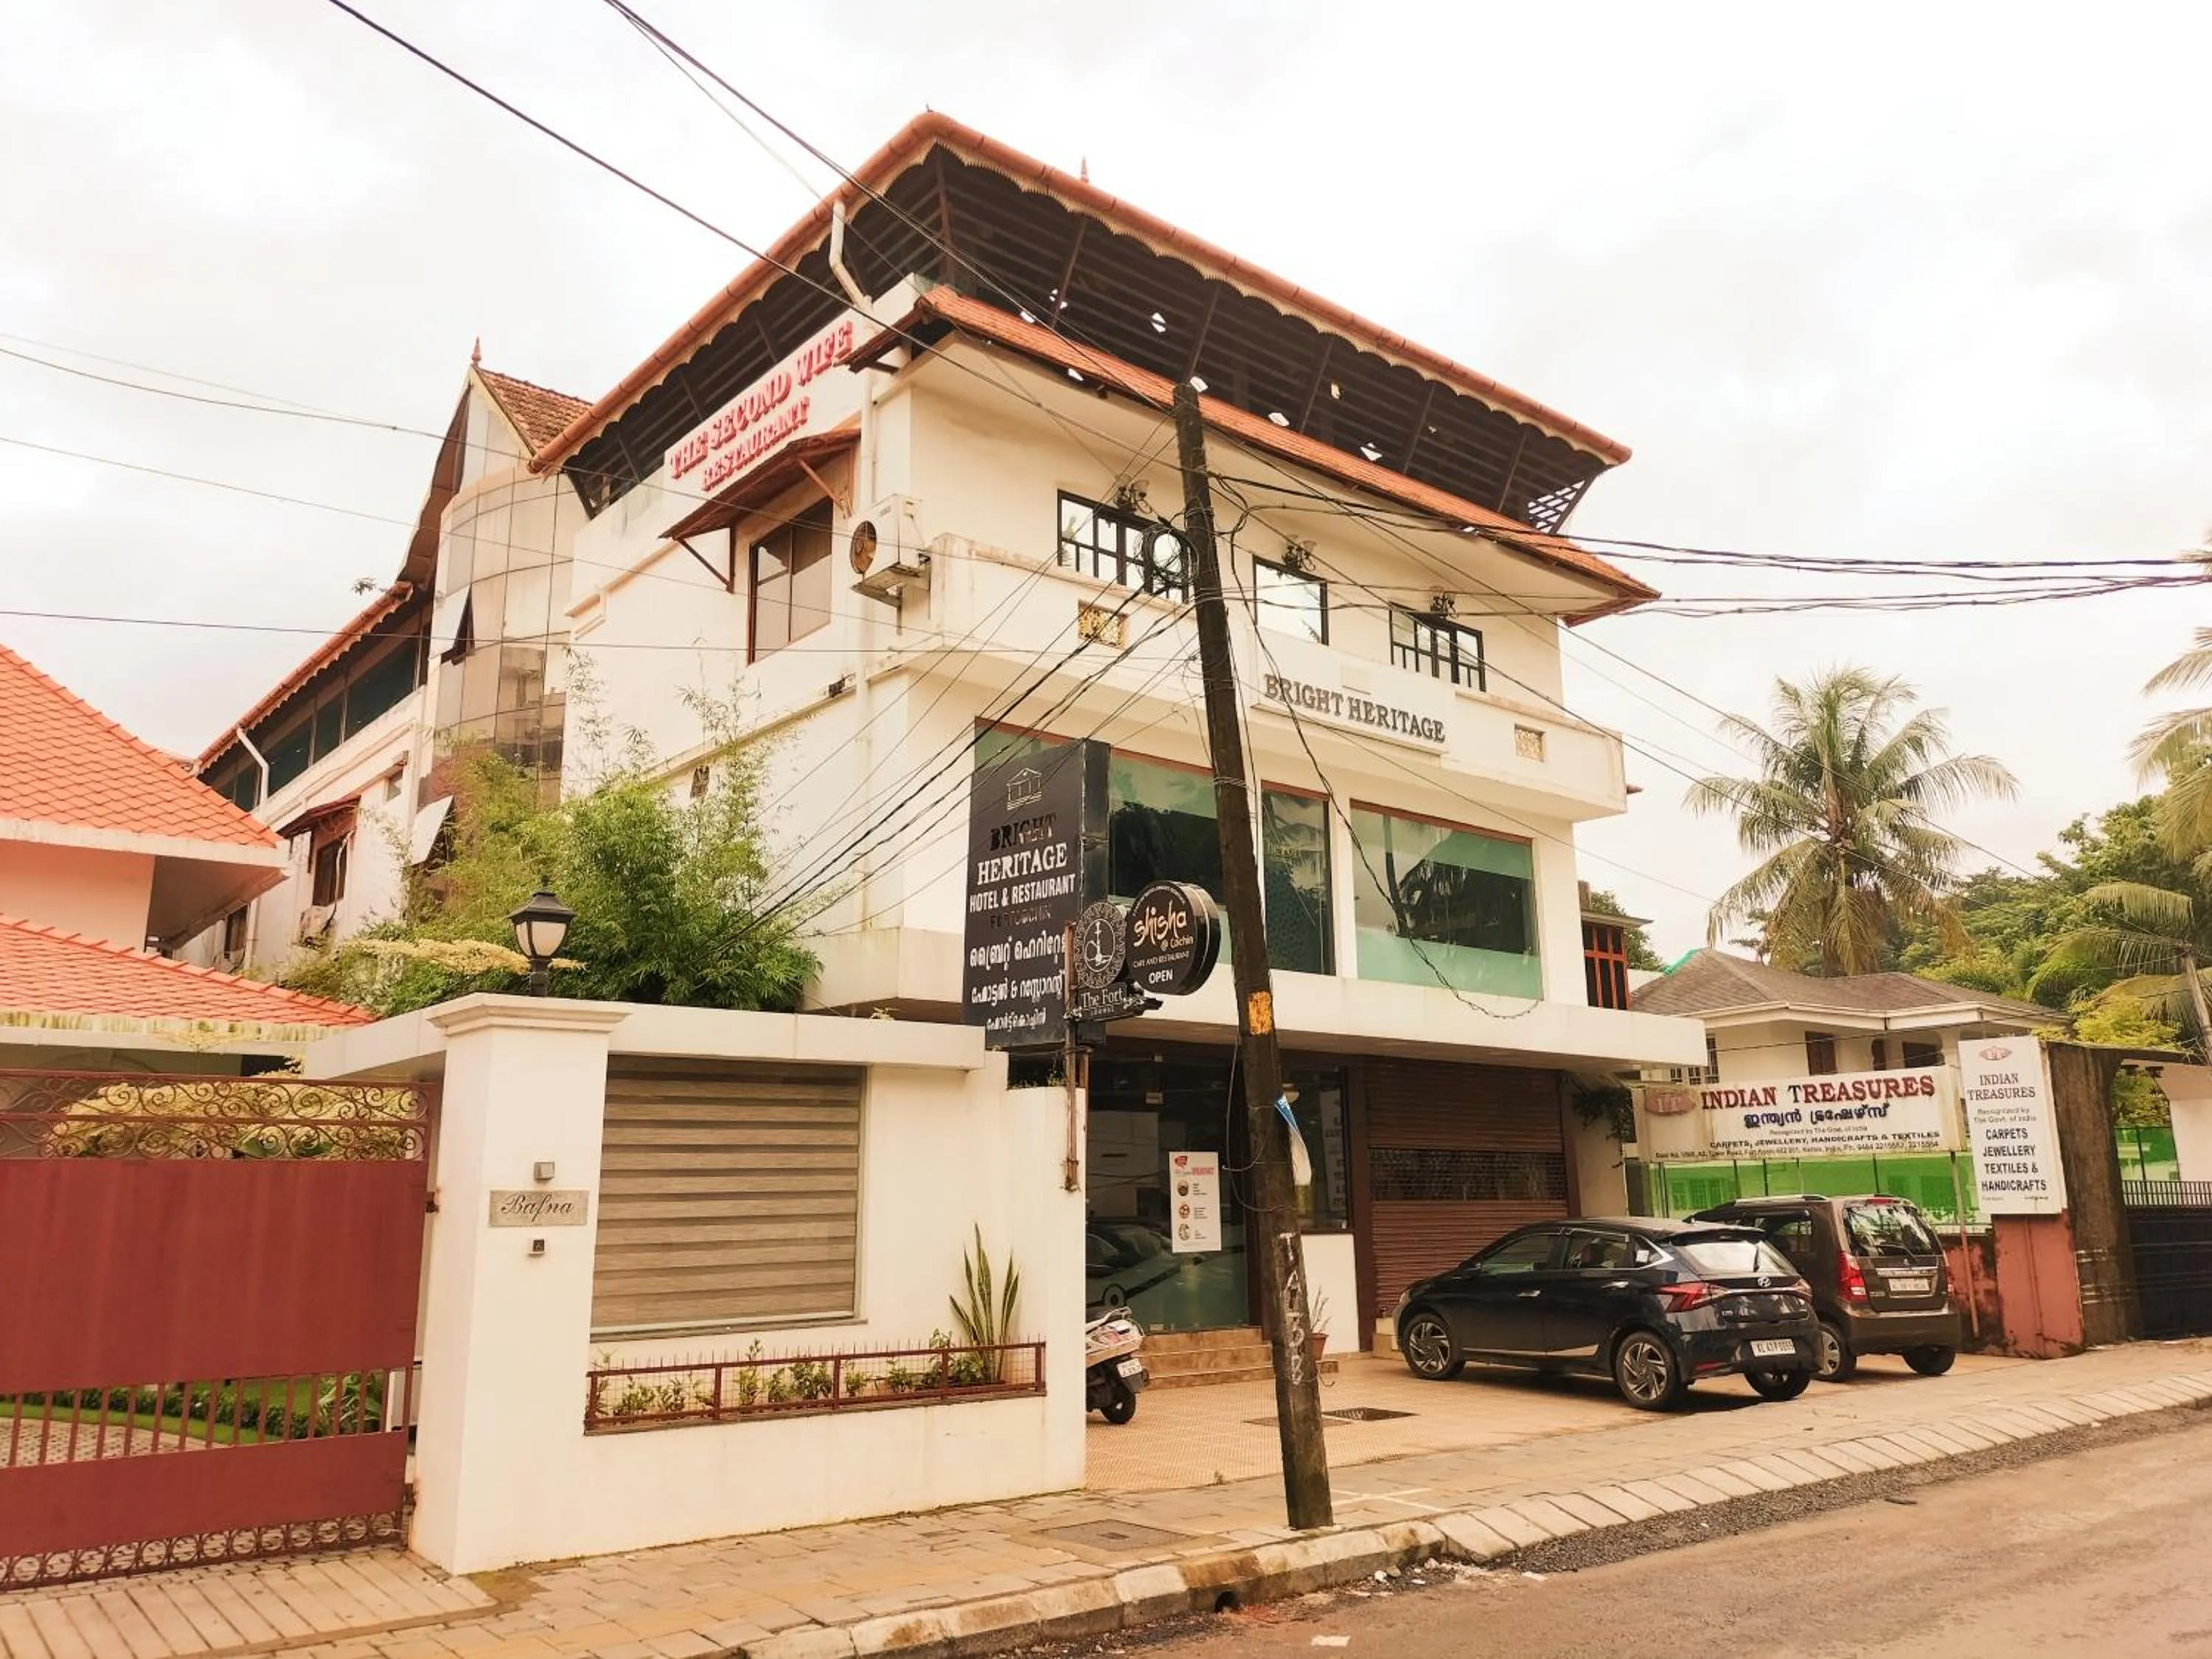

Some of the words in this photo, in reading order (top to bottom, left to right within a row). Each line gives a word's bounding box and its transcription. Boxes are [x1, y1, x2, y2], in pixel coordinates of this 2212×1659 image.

[670, 430, 709, 479] THE
[710, 370, 793, 451] SECOND
[796, 320, 854, 387] WIFE
[701, 395, 810, 492] RESTAURANT
[1264, 673, 1344, 717] BRIGHT
[1347, 696, 1446, 743] HERITAGE
[977, 842, 1068, 886] HERITAGE
[970, 889, 1000, 914] HOTEL
[1001, 887, 1009, 908] &
[1011, 873, 1077, 905] RESTAURANT
[1133, 898, 1187, 947] shisha
[1148, 968, 1174, 984] OPEN
[1010, 979, 1018, 999] &
[1081, 991, 1100, 1009] The
[1101, 987, 1123, 1005] Fort
[1979, 1073, 2020, 1086] INDIAN
[1700, 1085, 1777, 1110] INDIAN
[1787, 1075, 1936, 1105] TREASURES
[1967, 1086, 2036, 1100] TREASURES
[1811, 1134, 1879, 1144] HANDICRAFTS
[1891, 1131, 1940, 1141] TEXTILES
[1985, 1127, 2028, 1141] CARPETS
[1983, 1144, 2037, 1157] JEWELLERY
[1984, 1162, 2028, 1175] TEXTILES
[2031, 1161, 2039, 1173] &
[1981, 1180, 2048, 1192] HANDICRAFTS
[501, 1192, 574, 1222] Bafna
